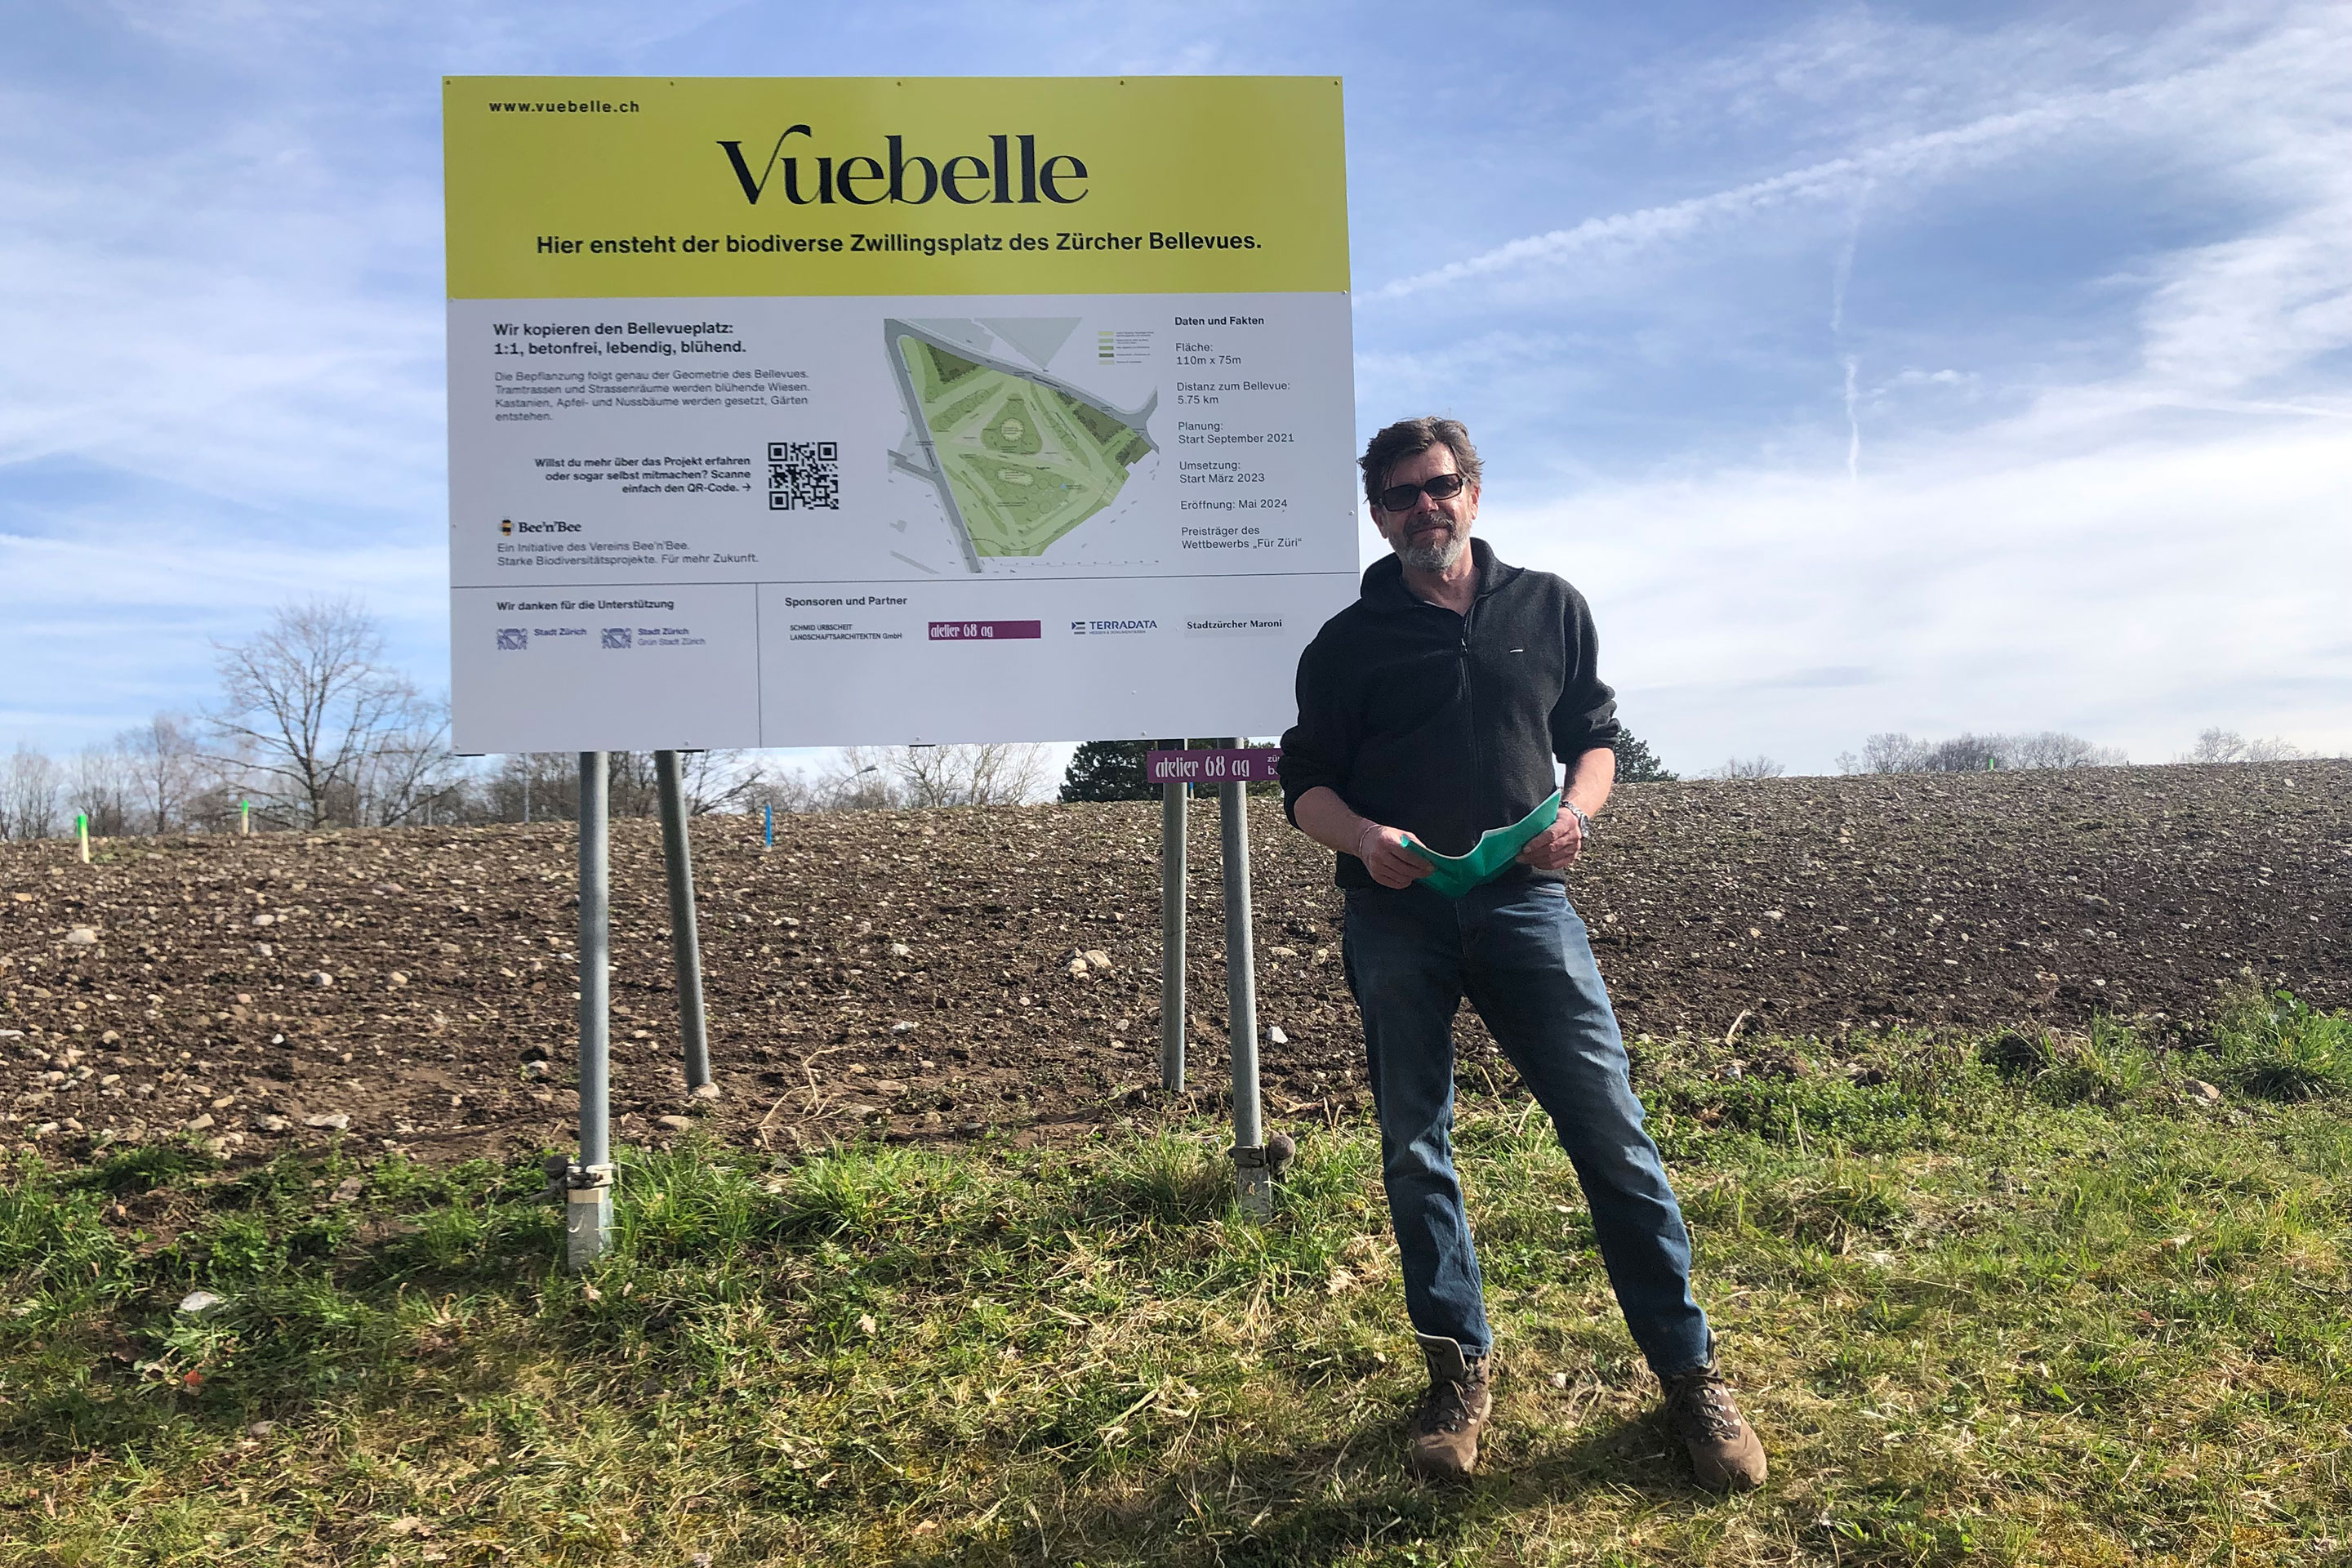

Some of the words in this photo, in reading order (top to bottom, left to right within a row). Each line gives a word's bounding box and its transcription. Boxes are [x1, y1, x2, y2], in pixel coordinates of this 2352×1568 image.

[489, 100, 639, 112] www.vuebelle.ch
[716, 124, 1089, 205] Vuebelle
[537, 236, 583, 253] Hier
[590, 235, 676, 253] ensteht
[683, 235, 719, 252] der
[727, 234, 843, 252] biodiverse
[850, 234, 1002, 256] Zwillingsplatz
[1009, 234, 1049, 250] des
[1056, 233, 1142, 250] Zürcher
[1150, 232, 1261, 249] Bellevues.
[1175, 317, 1205, 325] Daten
[1208, 317, 1227, 325] und
[1230, 316, 1263, 324] Fakten
[493, 324, 519, 335] Wir
[523, 323, 590, 338] kopieren
[595, 323, 622, 335] den
[628, 322, 733, 336] Bellevueplatz:
[494, 343, 523, 356] 1:1,
[528, 342, 602, 355] betonfrei,
[607, 341, 676, 356] lebendig,
[681, 341, 746, 353] blühend.
[1176, 343, 1213, 351] Fläche:
[1177, 356, 1206, 364] 110m
[1219, 355, 1241, 364] 75m
[495, 372, 513, 381] Die
[516, 372, 584, 382] Bepflanzung
[588, 372, 612, 382] folgt
[615, 372, 648, 382] genau
[673, 370, 729, 379] Geometrie
[732, 370, 751, 378] des
[755, 369, 808, 378] Bellevues.
[496, 385, 561, 394] Tramtrassen
[565, 385, 585, 394] und
[588, 384, 669, 393] Strassenräume
[715, 383, 764, 392] blühende
[768, 383, 809, 391] Wiesen.
[1177, 382, 1215, 391] Distanz
[1244, 381, 1290, 390] Bellevue:
[616, 397, 679, 407] Nussbäume
[682, 397, 722, 405] werden
[771, 395, 808, 404] Gärten
[1178, 395, 1200, 404] 5.75
[1204, 395, 1218, 403] km
[495, 412, 552, 421] entstehen.
[1178, 422, 1223, 432] Planung:
[1178, 435, 1204, 443] Start
[1208, 434, 1263, 444] September
[1267, 434, 1294, 442] 2021
[535, 459, 564, 467] Willst
[584, 458, 612, 466] mehr
[615, 457, 639, 466] über
[664, 457, 702, 467] Projekt
[705, 457, 751, 465] erfahren
[1180, 461, 1240, 471] Umsetzung:
[546, 472, 570, 480] oder
[572, 472, 604, 483] sogar
[607, 470, 640, 480] selbst
[643, 470, 708, 479] mitmachen?
[711, 470, 751, 479] Scanne
[1180, 474, 1205, 483] Start
[1209, 474, 1233, 483] März
[1238, 473, 1264, 482] 2023
[622, 484, 662, 493] einfach
[664, 484, 684, 492] den
[688, 483, 739, 492] QR-Code.
[1181, 501, 1235, 510] Eröffnung:
[1239, 500, 1257, 508] Mai
[1261, 499, 1287, 508] 2024
[1182, 527, 1238, 537] Preisträger
[1241, 526, 1259, 534] des
[497, 543, 514, 552] Ein
[518, 542, 564, 553] Initiative
[567, 542, 586, 552] des
[589, 542, 630, 551] Vereins
[1182, 540, 1249, 549] Wettbewerbs
[497, 557, 532, 566] Starke
[537, 555, 657, 566] Biodiversitätsprojekte.
[662, 554, 679, 564] Für
[683, 555, 710, 563] mehr
[713, 554, 758, 563] Zukunft.
[497, 602, 515, 610] Wir
[518, 602, 558, 610] danken
[560, 601, 576, 609] für
[578, 601, 595, 609] die
[598, 599, 674, 610] Unterstützung
[785, 598, 843, 608] Sponsoren
[846, 597, 865, 605] und
[869, 596, 907, 605] Partner
[1089, 621, 1157, 630] TERRADATA
[1187, 620, 1247, 629] Stadtzürcher
[1250, 619, 1281, 627] Maroni
[931, 624, 960, 637] atelier
[964, 624, 977, 636] 68
[981, 626, 993, 637] ag
[1156, 757, 1198, 777] atelier
[1205, 756, 1225, 776] 68
[1232, 760, 1250, 777] ag
